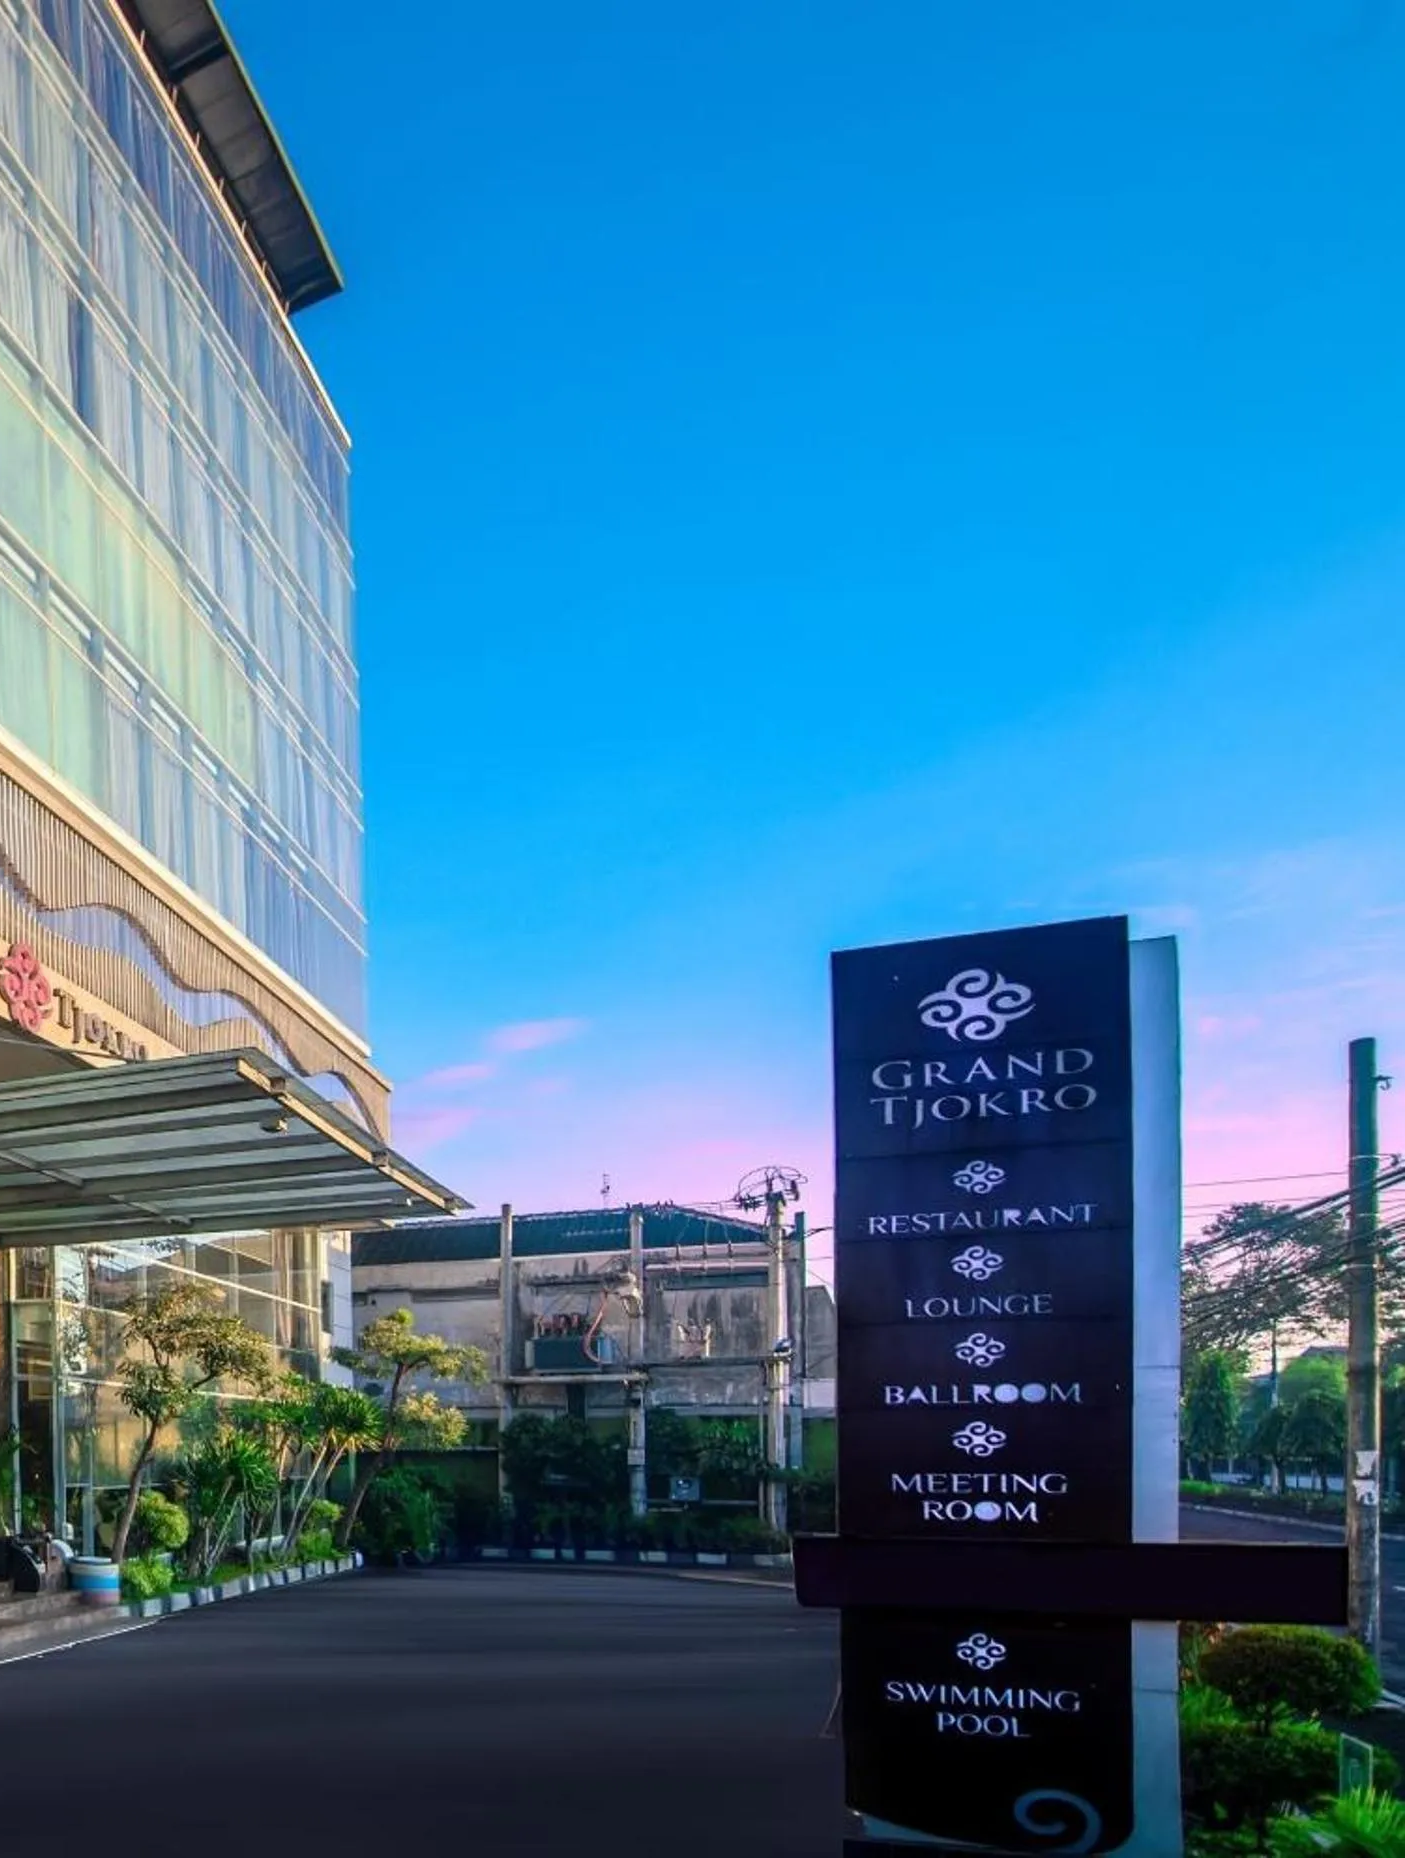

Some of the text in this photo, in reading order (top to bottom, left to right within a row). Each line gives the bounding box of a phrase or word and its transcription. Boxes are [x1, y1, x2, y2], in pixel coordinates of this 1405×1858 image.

[871, 1047, 1094, 1091] GRAND
[870, 1083, 1098, 1129] TJOKRO
[868, 1203, 1098, 1236] RESTAURANT
[904, 1294, 1054, 1319] LOUNGE
[884, 1383, 1083, 1405] BALLROOM
[890, 1472, 1069, 1496] MEETING
[923, 1500, 1040, 1524] ROOM
[885, 1680, 1081, 1713] SWIMMING
[936, 1710, 1032, 1738] POOL
